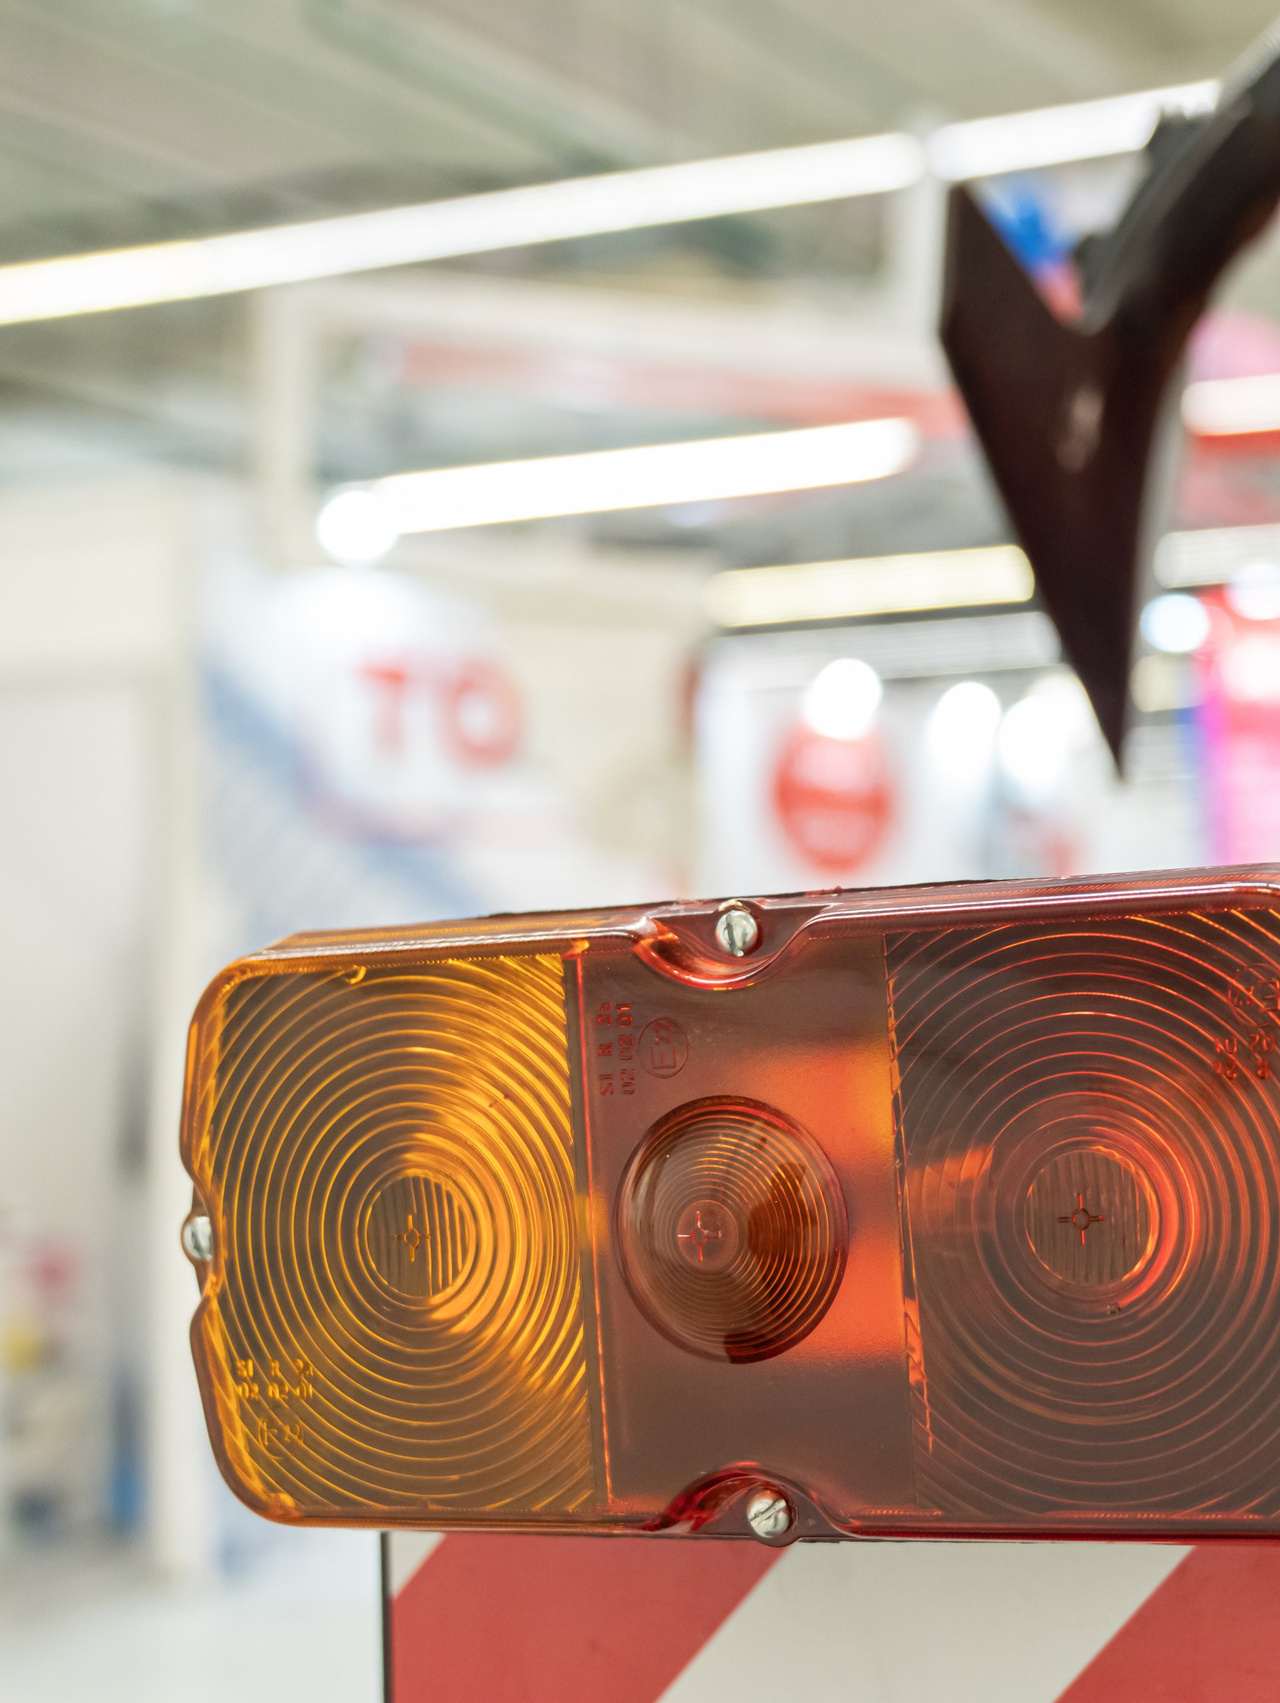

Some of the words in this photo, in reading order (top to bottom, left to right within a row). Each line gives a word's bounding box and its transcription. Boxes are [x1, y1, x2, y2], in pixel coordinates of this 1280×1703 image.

[616, 1002, 633, 1028] 01
[598, 1043, 614, 1057] R
[618, 1034, 634, 1061] 02
[620, 1068, 635, 1096] 02
